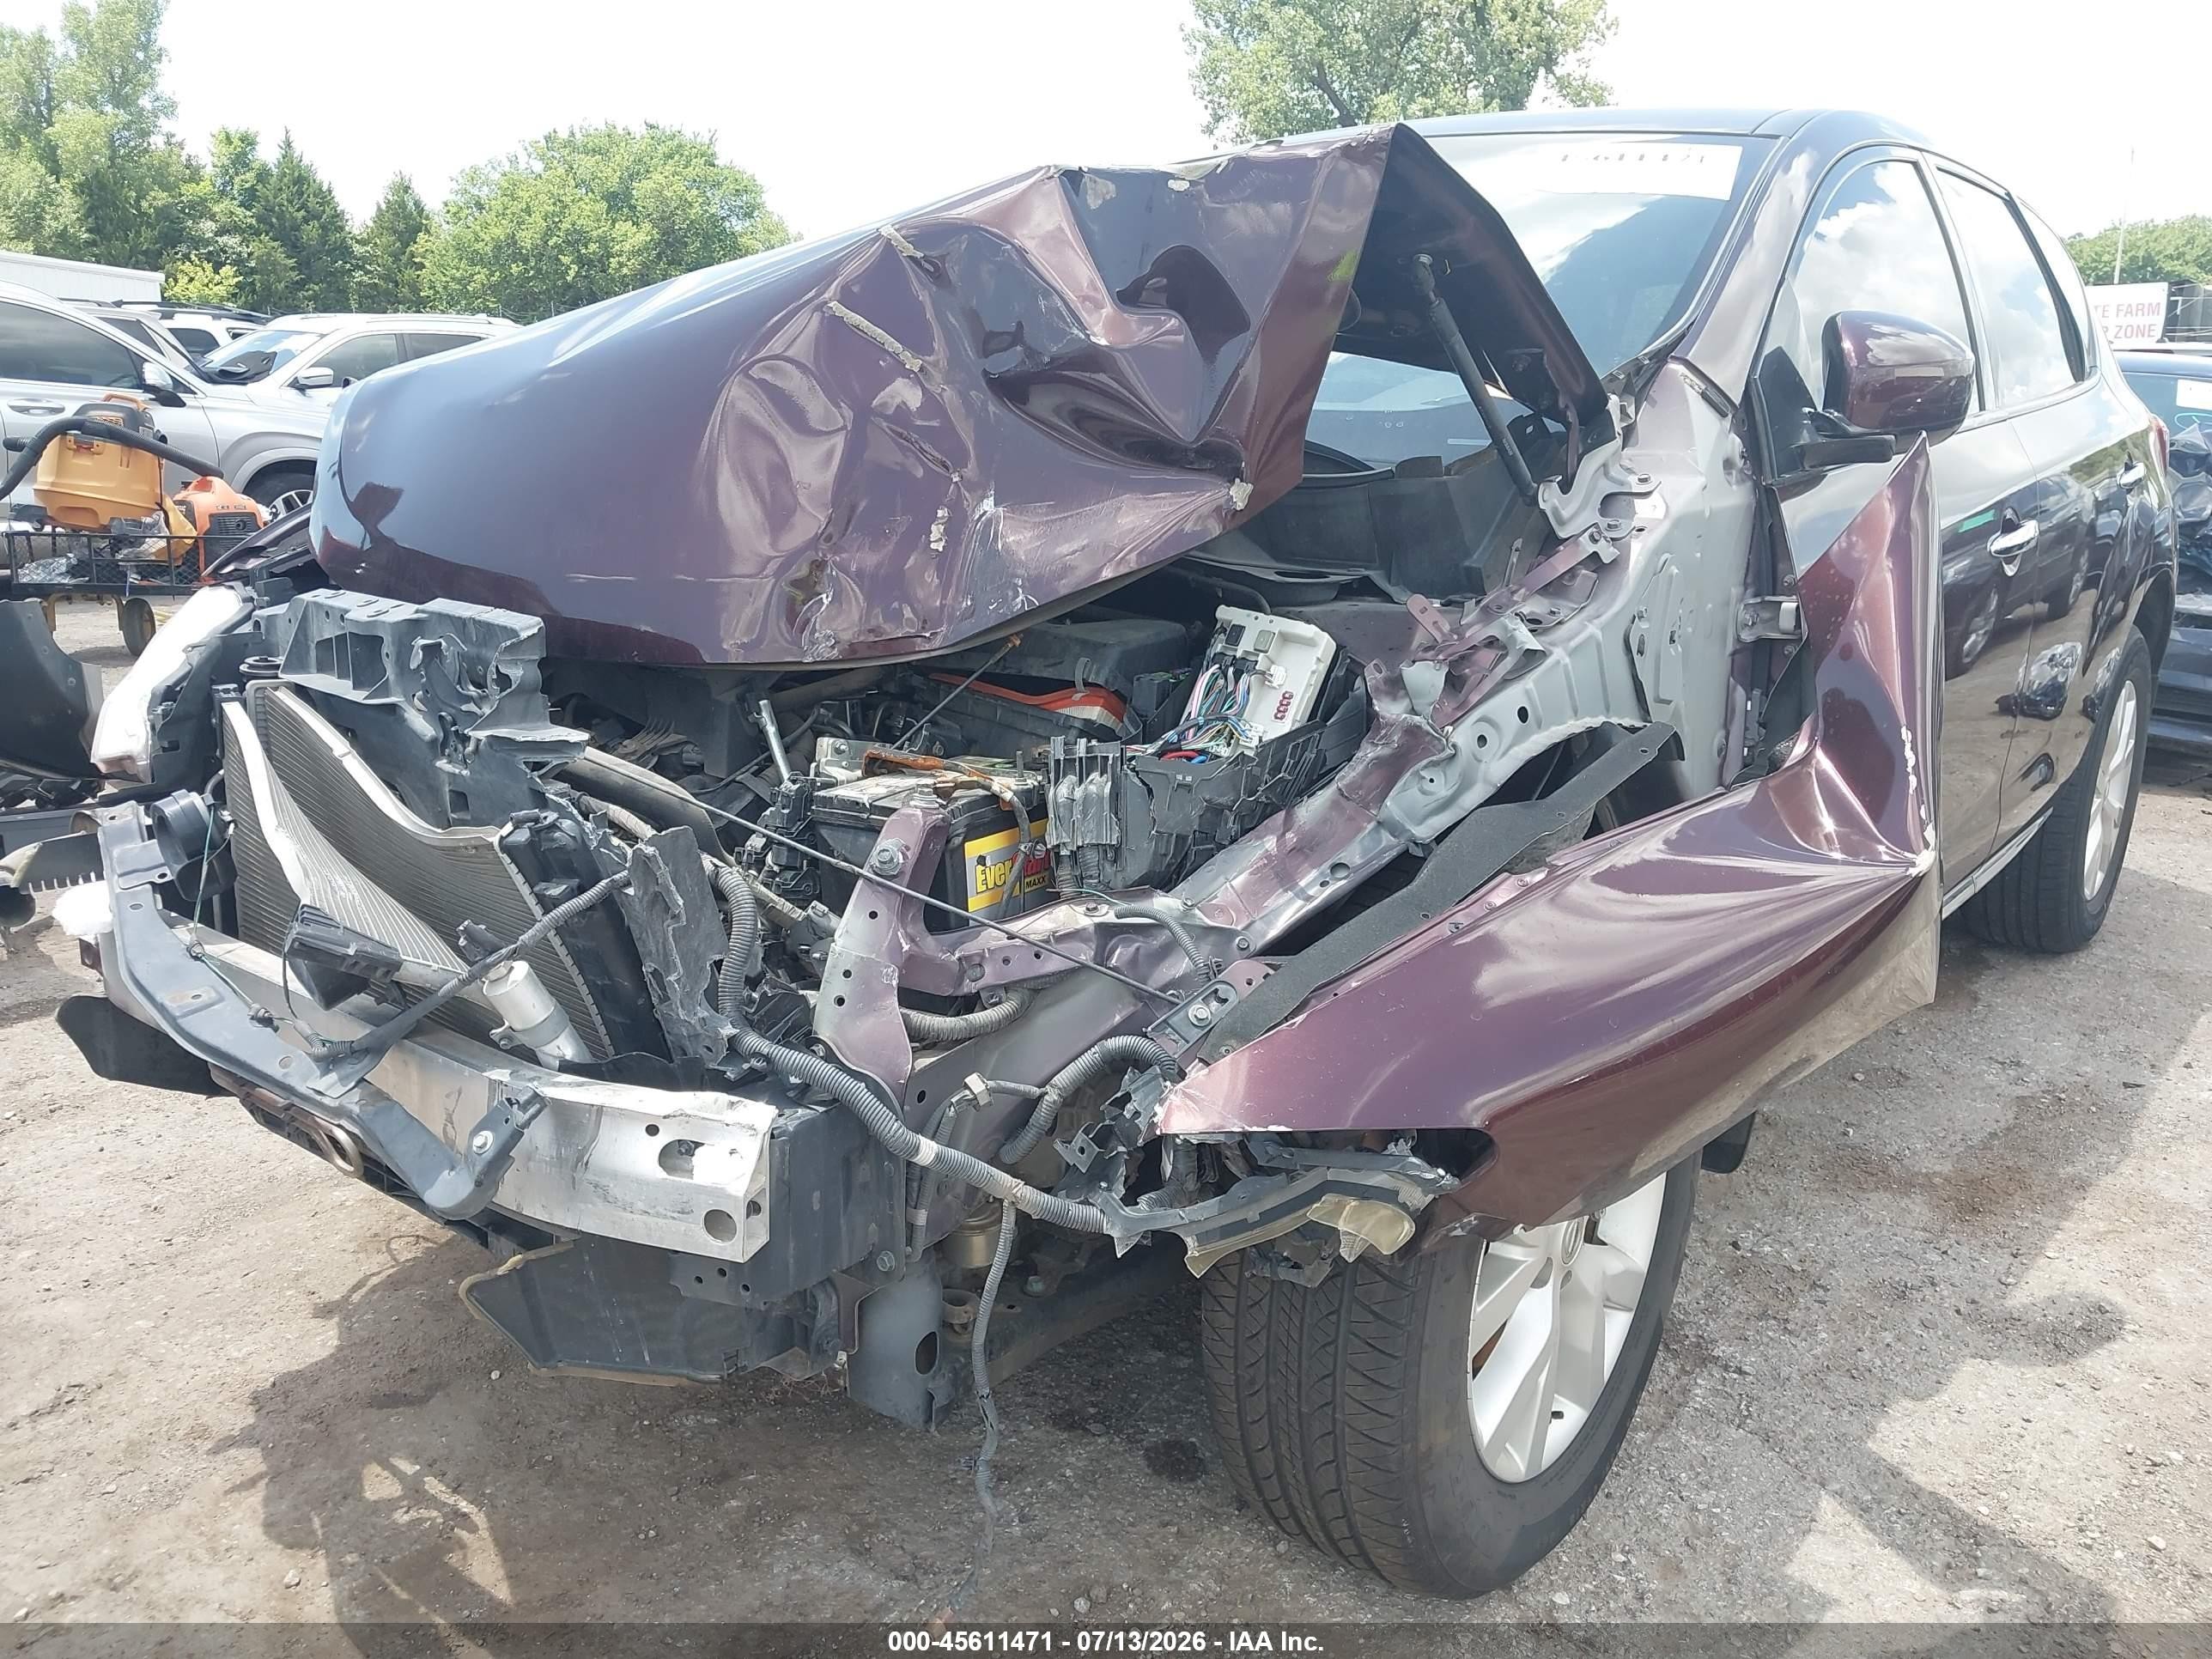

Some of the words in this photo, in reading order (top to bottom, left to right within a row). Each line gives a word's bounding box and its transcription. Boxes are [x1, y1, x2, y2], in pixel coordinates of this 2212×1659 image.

[2116, 302, 2161, 318] FARM
[2114, 323, 2158, 339] ZONE
[1026, 875, 1046, 890] MAXX
